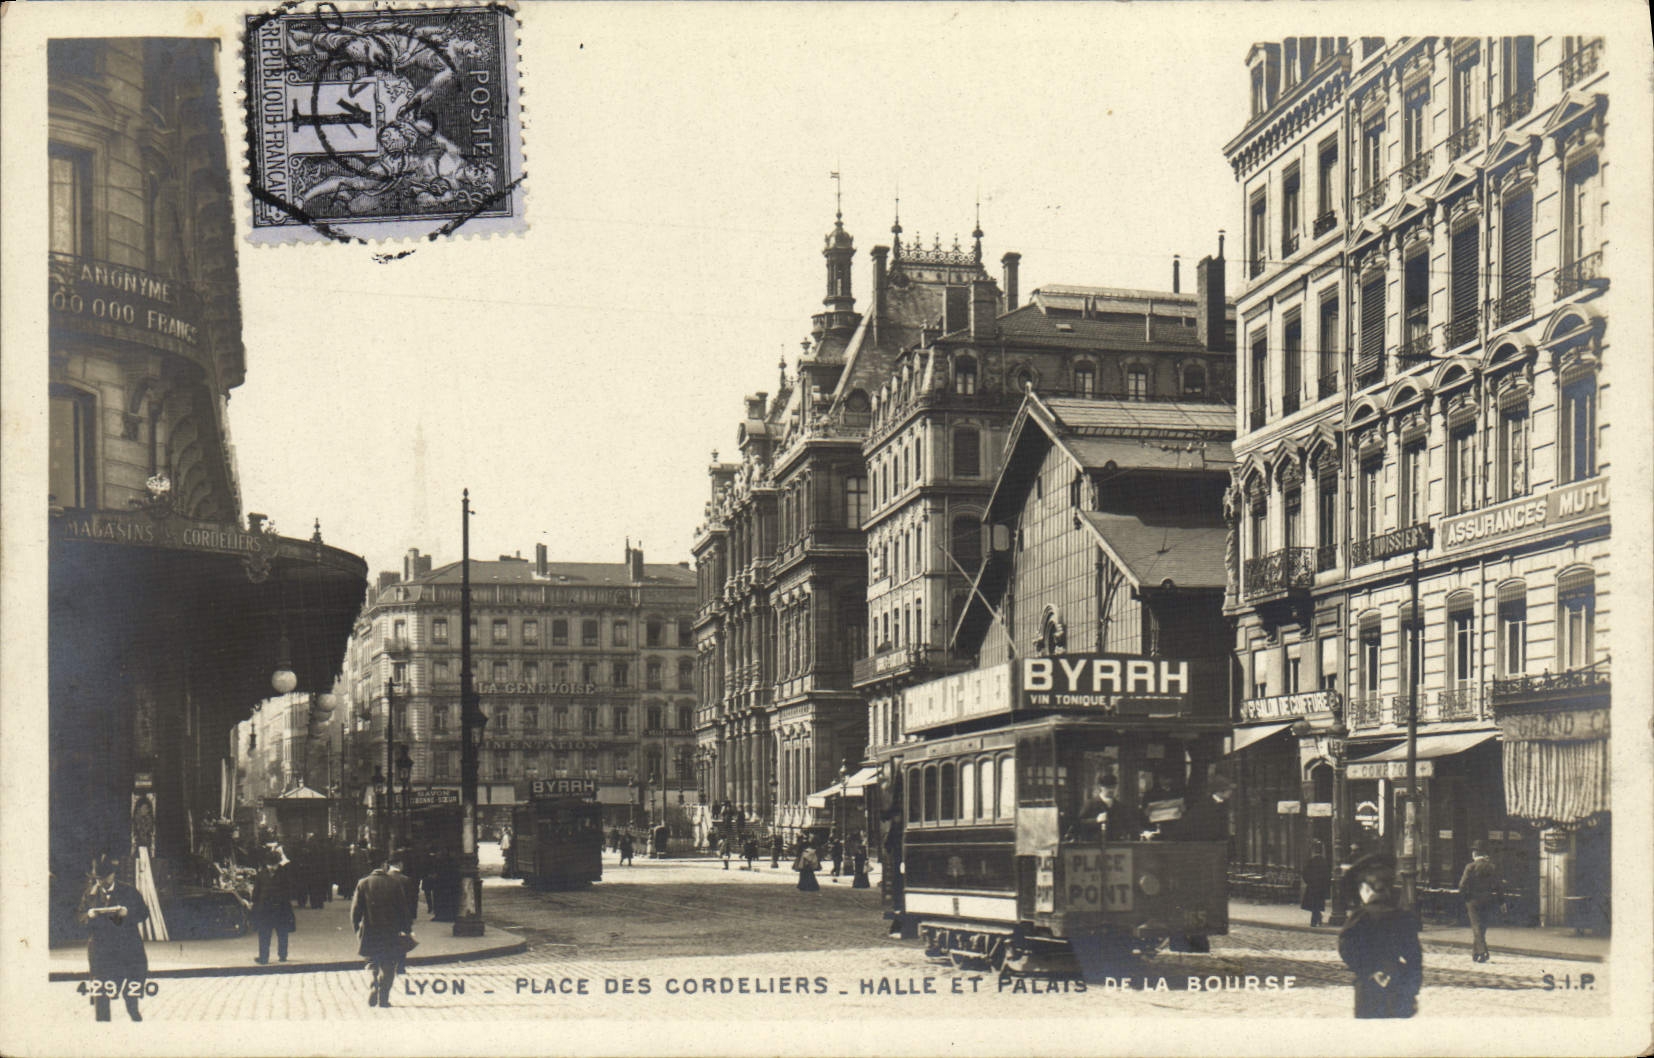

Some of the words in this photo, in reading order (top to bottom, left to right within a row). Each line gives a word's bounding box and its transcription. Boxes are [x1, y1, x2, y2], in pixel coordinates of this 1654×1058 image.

[292, 98, 375, 133] 1
[469, 70, 494, 157] POSTE
[80, 264, 172, 303] ANONYME
[65, 520, 154, 543] MAGASINS
[1447, 500, 1547, 545] ASSURANCES
[183, 527, 262, 552] CORDELIERS
[1023, 658, 1188, 694] BYRRH
[478, 682, 498, 694] LA
[504, 682, 595, 695] GENEVOISE
[1030, 694, 1050, 705] VIN
[1055, 694, 1106, 707] TONIQUE
[533, 780, 595, 793] BYRRH
[1072, 854, 1125, 873] PLACE
[1069, 884, 1130, 905] PONT
